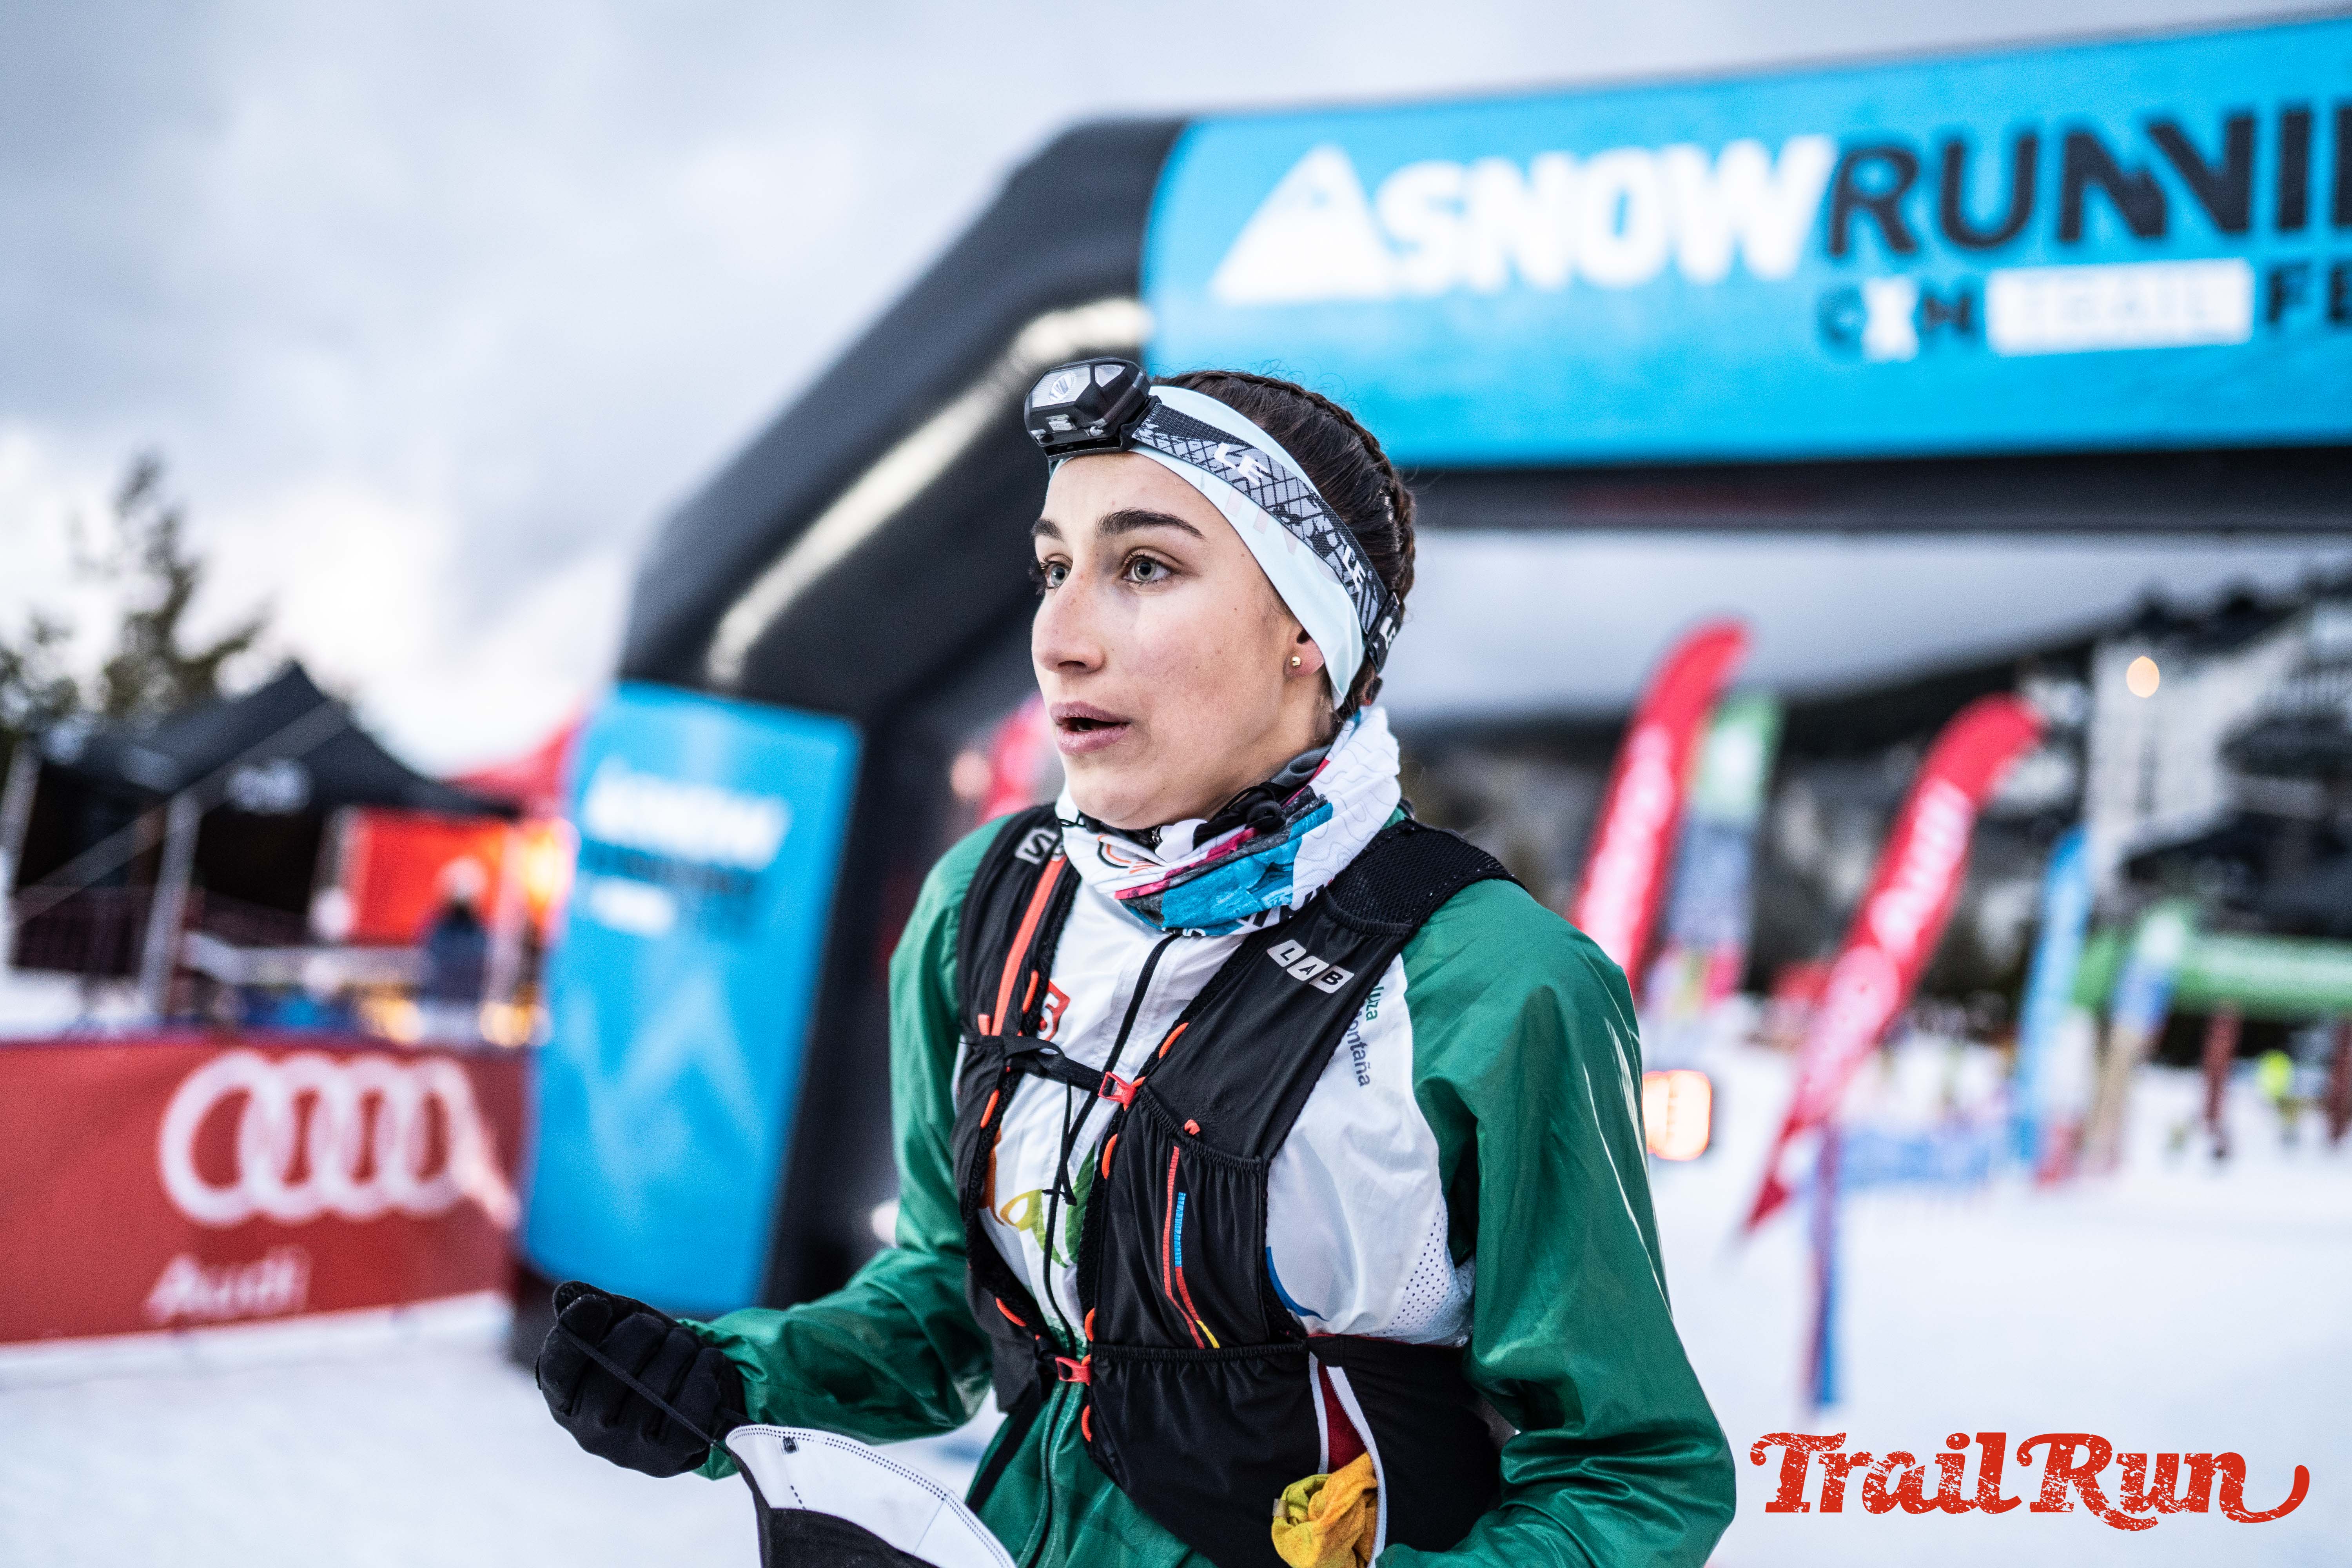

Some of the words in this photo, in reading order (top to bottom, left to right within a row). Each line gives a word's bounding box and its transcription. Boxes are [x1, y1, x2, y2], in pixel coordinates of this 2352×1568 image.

[1214, 442, 1269, 487] LE
[1342, 544, 1366, 591] LE
[1279, 946, 1345, 986] LAB
[1347, 1011, 1371, 1087] ontaña
